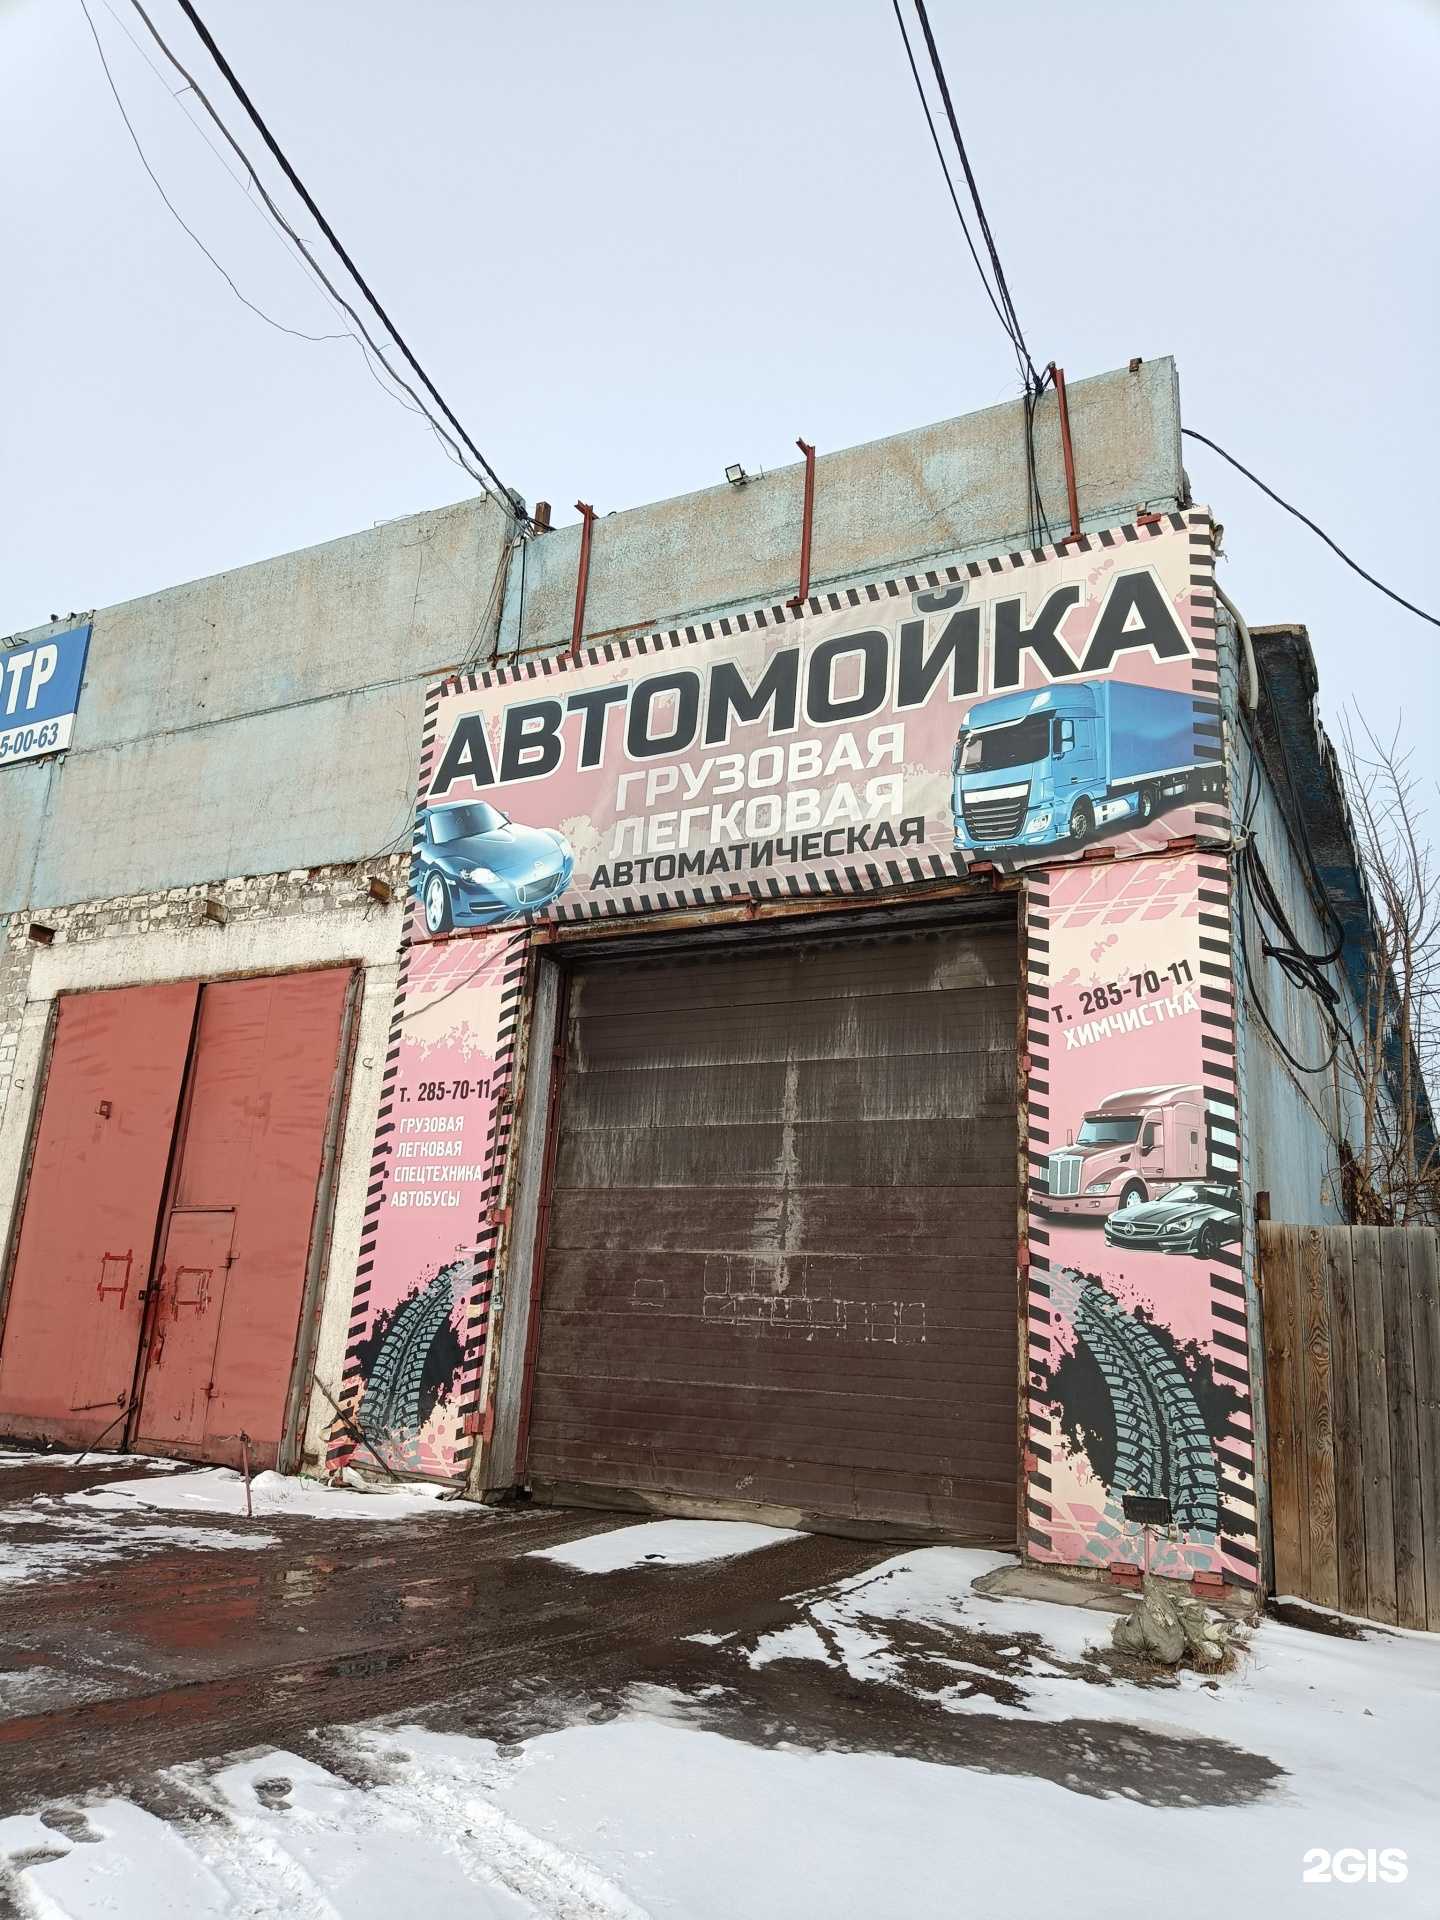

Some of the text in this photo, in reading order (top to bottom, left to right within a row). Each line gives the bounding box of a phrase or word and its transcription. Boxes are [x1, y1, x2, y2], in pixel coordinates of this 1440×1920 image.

[0, 643, 57, 715] ТР
[428, 568, 1194, 798] АВТОМОЙКА
[616, 722, 905, 812] ГРУЗОВАЯ
[609, 773, 905, 859] ЛЕГКОВАЯ
[590, 816, 925, 890] АВТОМАТИЧЕСКАЯ
[1079, 959, 1194, 1016] 285-70-11
[1063, 990, 1200, 1050] ХИМЧИСТКА
[418, 1079, 491, 1102] 285-70-11
[396, 1141, 463, 1158] ЛЕГКОВАЯ
[400, 1116, 464, 1134] ГРУЗОВАЯ
[391, 1191, 461, 1207] АВТОБУСЫ
[394, 1165, 484, 1184] СПЕЦТЕХНИКА
